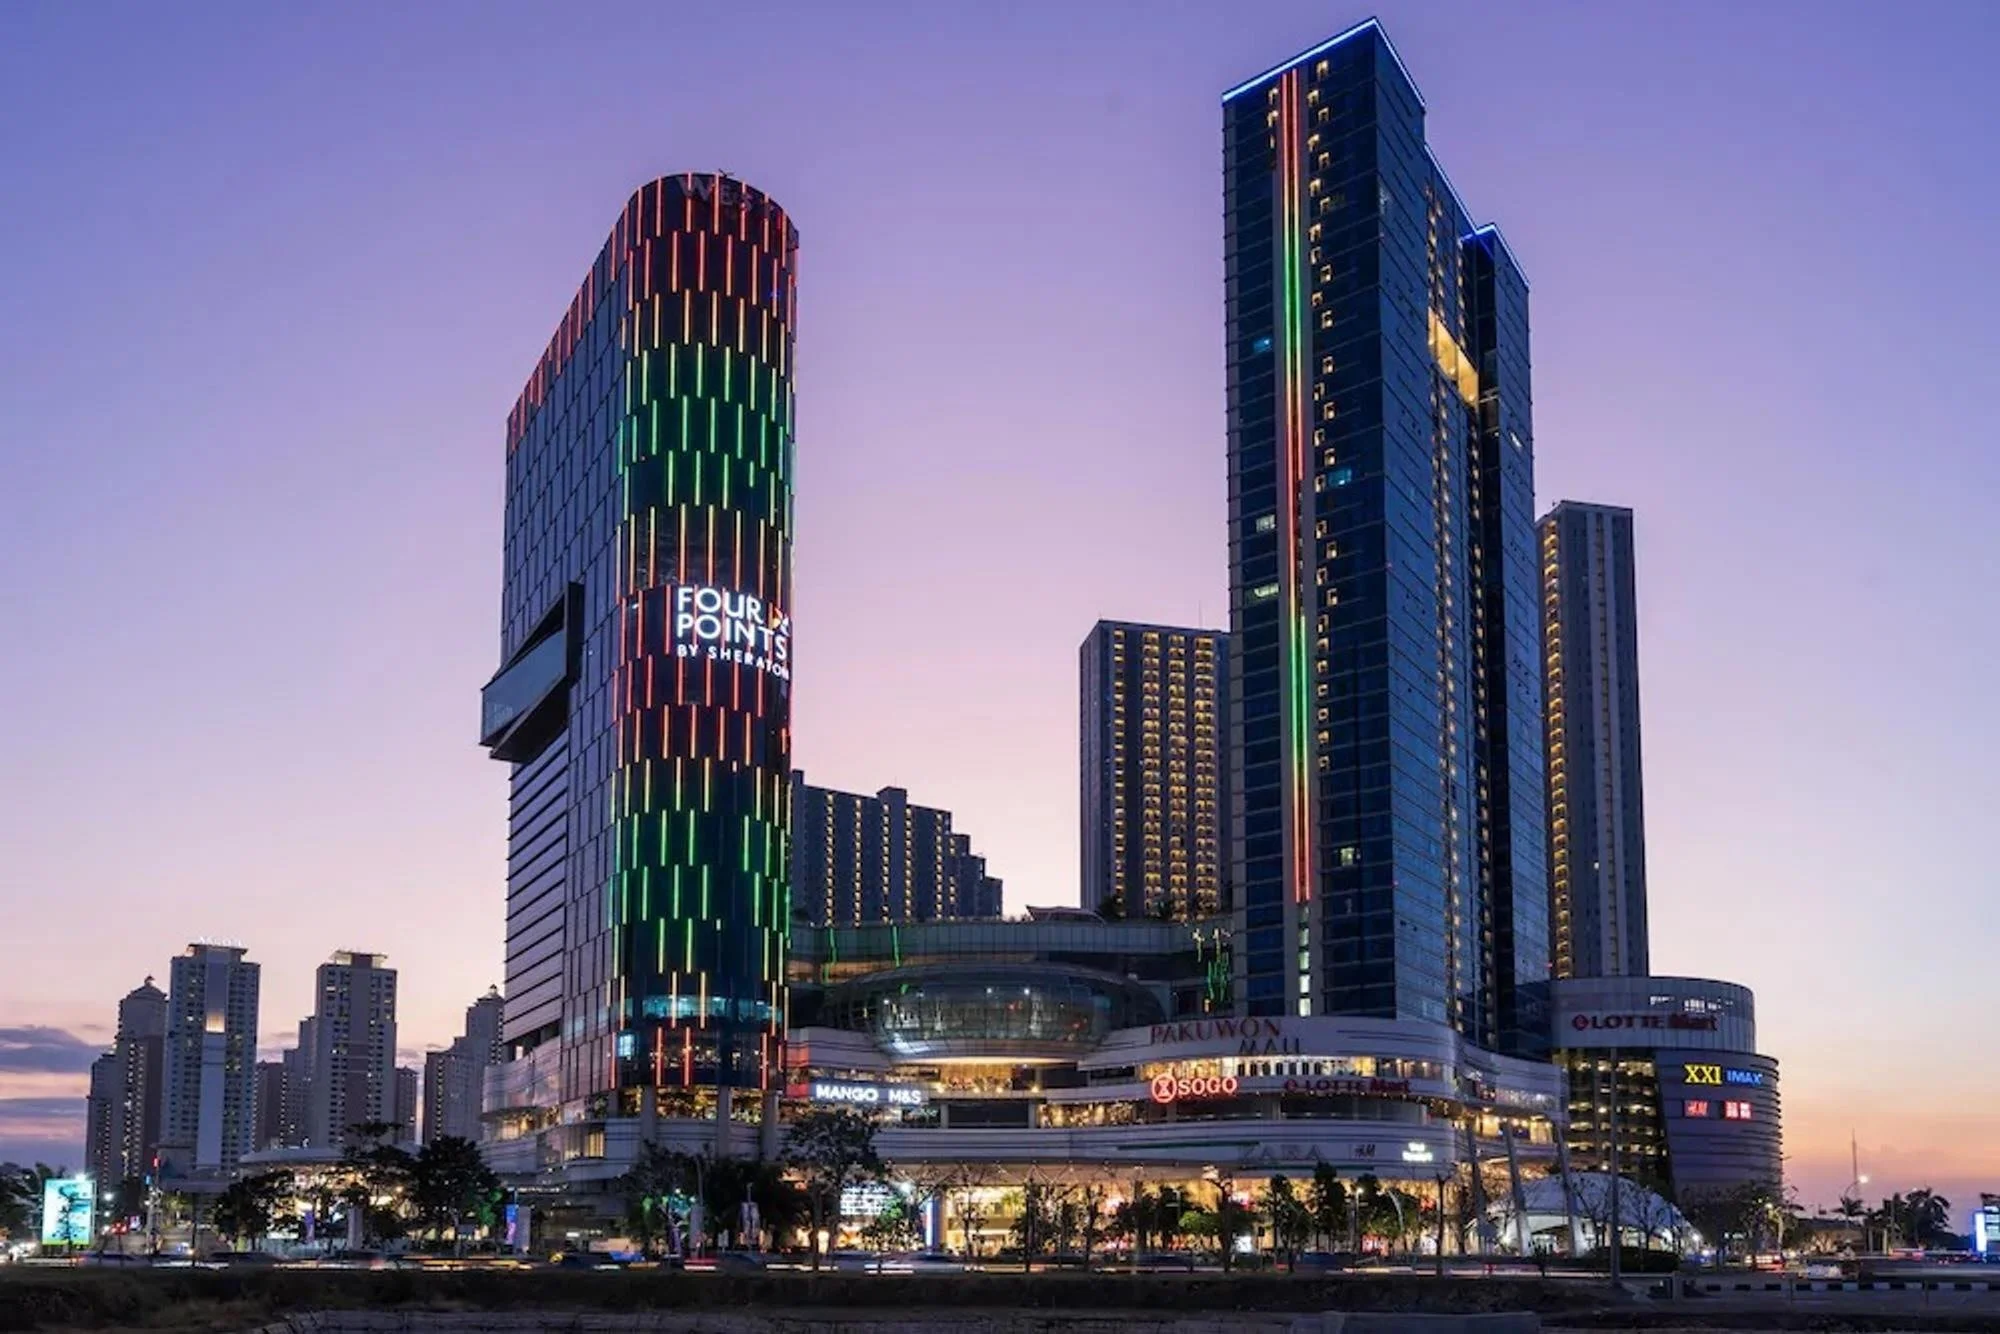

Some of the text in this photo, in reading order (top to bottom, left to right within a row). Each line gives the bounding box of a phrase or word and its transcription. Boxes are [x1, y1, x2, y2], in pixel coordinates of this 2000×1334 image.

[677, 587, 764, 624] FOUR
[677, 613, 788, 661] POINTS
[677, 644, 789, 680] BY SHERATON
[1150, 1018, 1281, 1045] PAKUWON
[1592, 1016, 1664, 1029] LOTTE
[1684, 1064, 1722, 1084] XXI
[1727, 1070, 1763, 1084] IMAX
[815, 1084, 879, 1101] MANGO
[1177, 1077, 1238, 1096] SOGO
[888, 1089, 921, 1104] M&S
